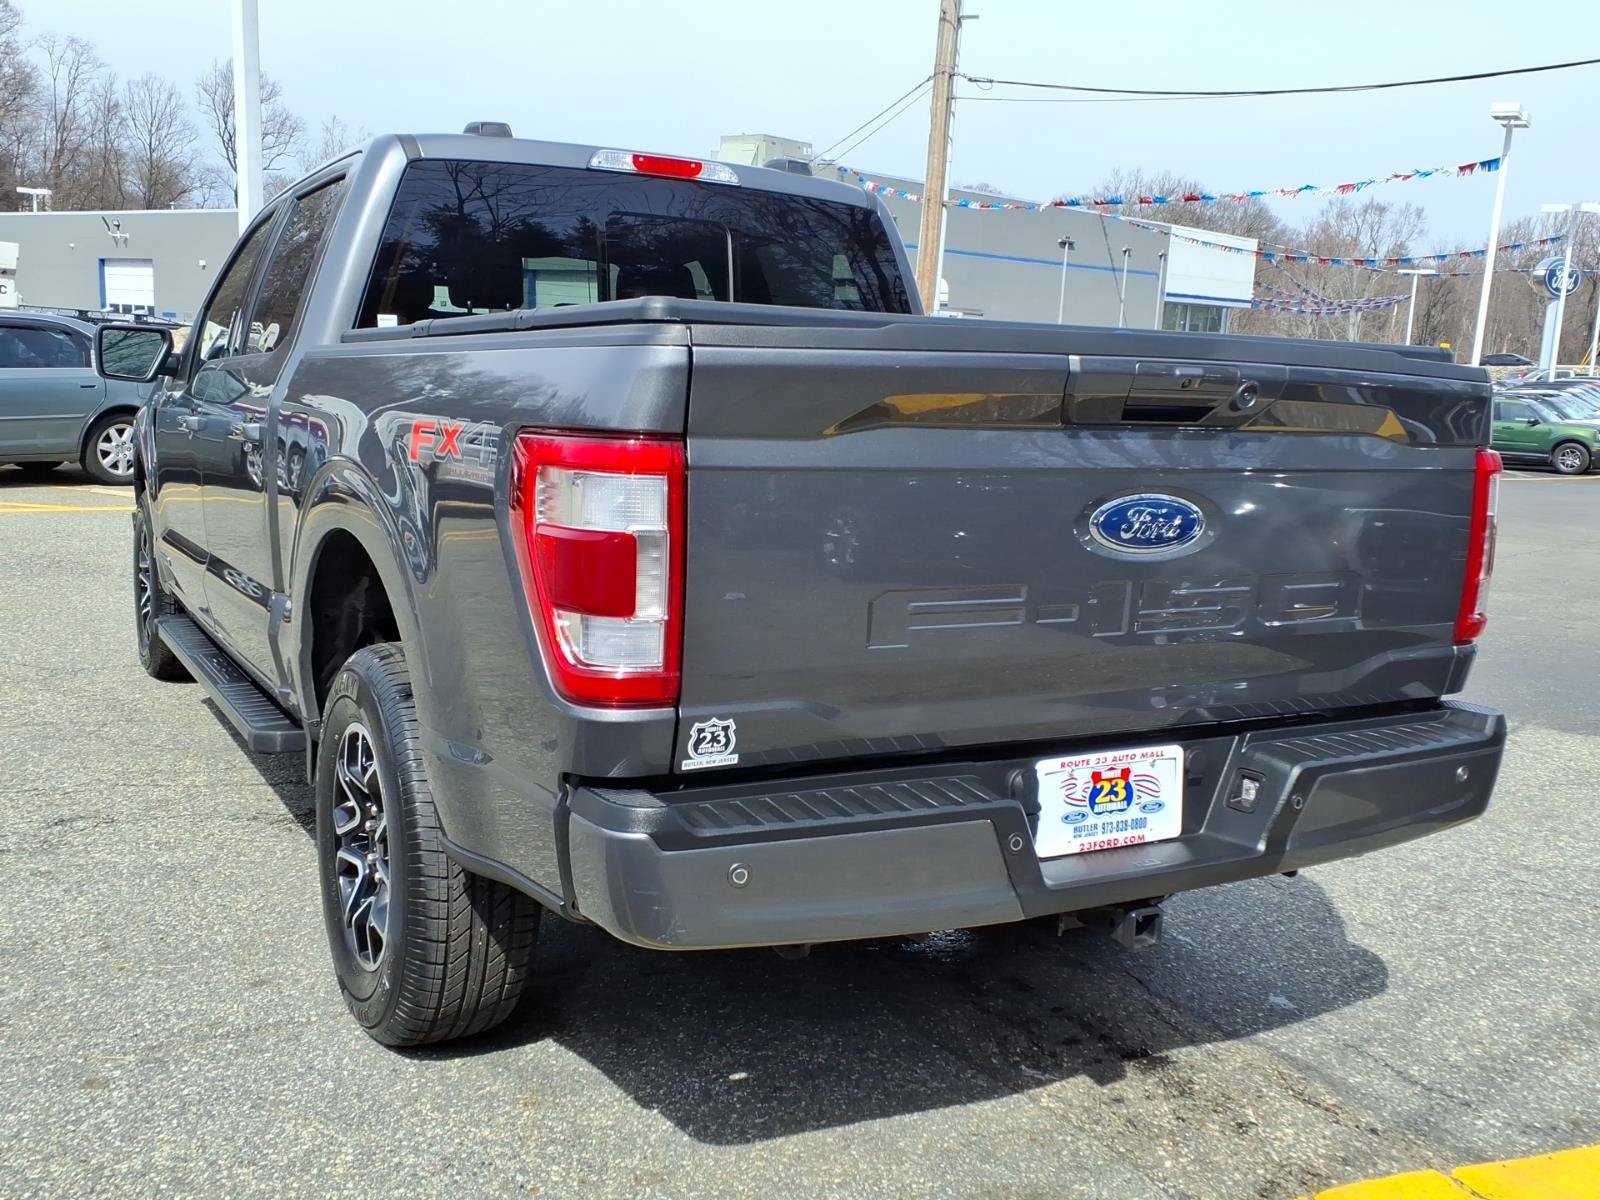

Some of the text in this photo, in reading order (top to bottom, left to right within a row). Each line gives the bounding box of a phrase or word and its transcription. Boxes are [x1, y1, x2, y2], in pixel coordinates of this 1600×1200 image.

[1551, 265, 1577, 290] Fod
[409, 418, 498, 470] FX4
[1120, 506, 1183, 540] Ford
[699, 731, 726, 749] 23
[1060, 750, 1165, 769] ROUTE 23 AUTO MALL
[1095, 779, 1127, 803] 23
[1073, 823, 1099, 833] BUTLER
[1079, 835, 1145, 851] 23FORD.COM
